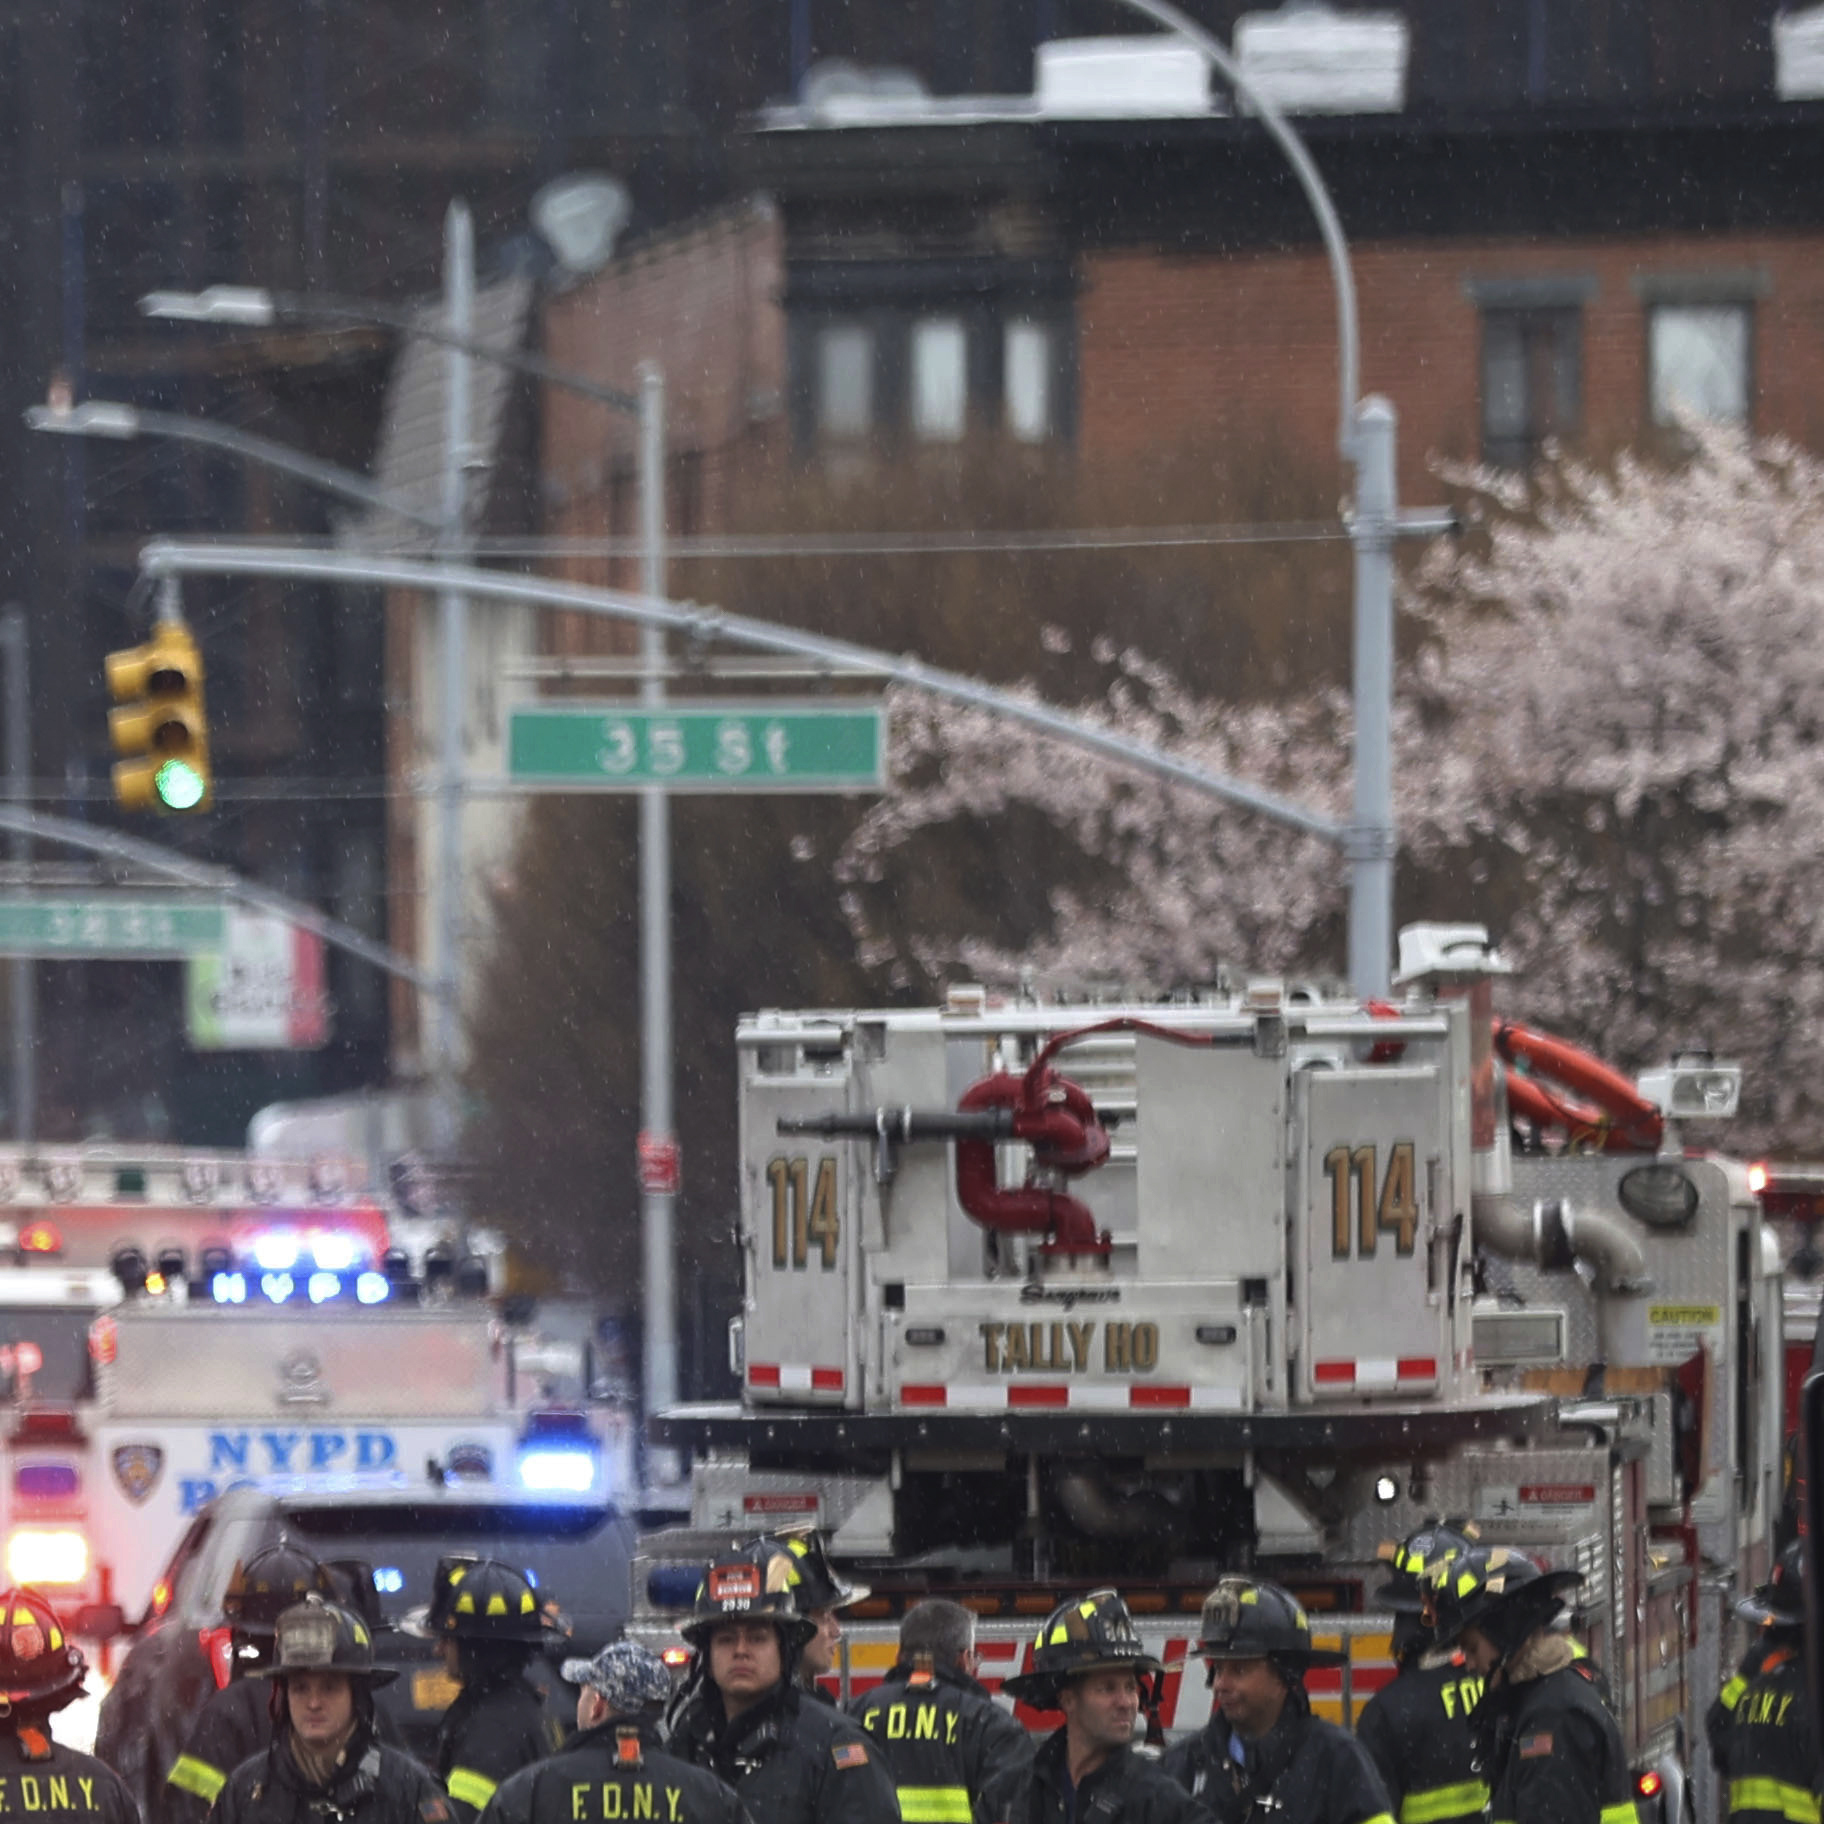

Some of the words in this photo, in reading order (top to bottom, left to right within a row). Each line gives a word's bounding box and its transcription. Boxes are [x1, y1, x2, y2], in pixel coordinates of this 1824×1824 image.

[599, 718, 686, 775] 35
[716, 718, 789, 775] St
[766, 1156, 840, 1271] 114
[1323, 1141, 1418, 1262] 114
[980, 1321, 1096, 1374] TALLY
[1105, 1321, 1160, 1373] HO
[211, 1434, 395, 1469] NYPD
